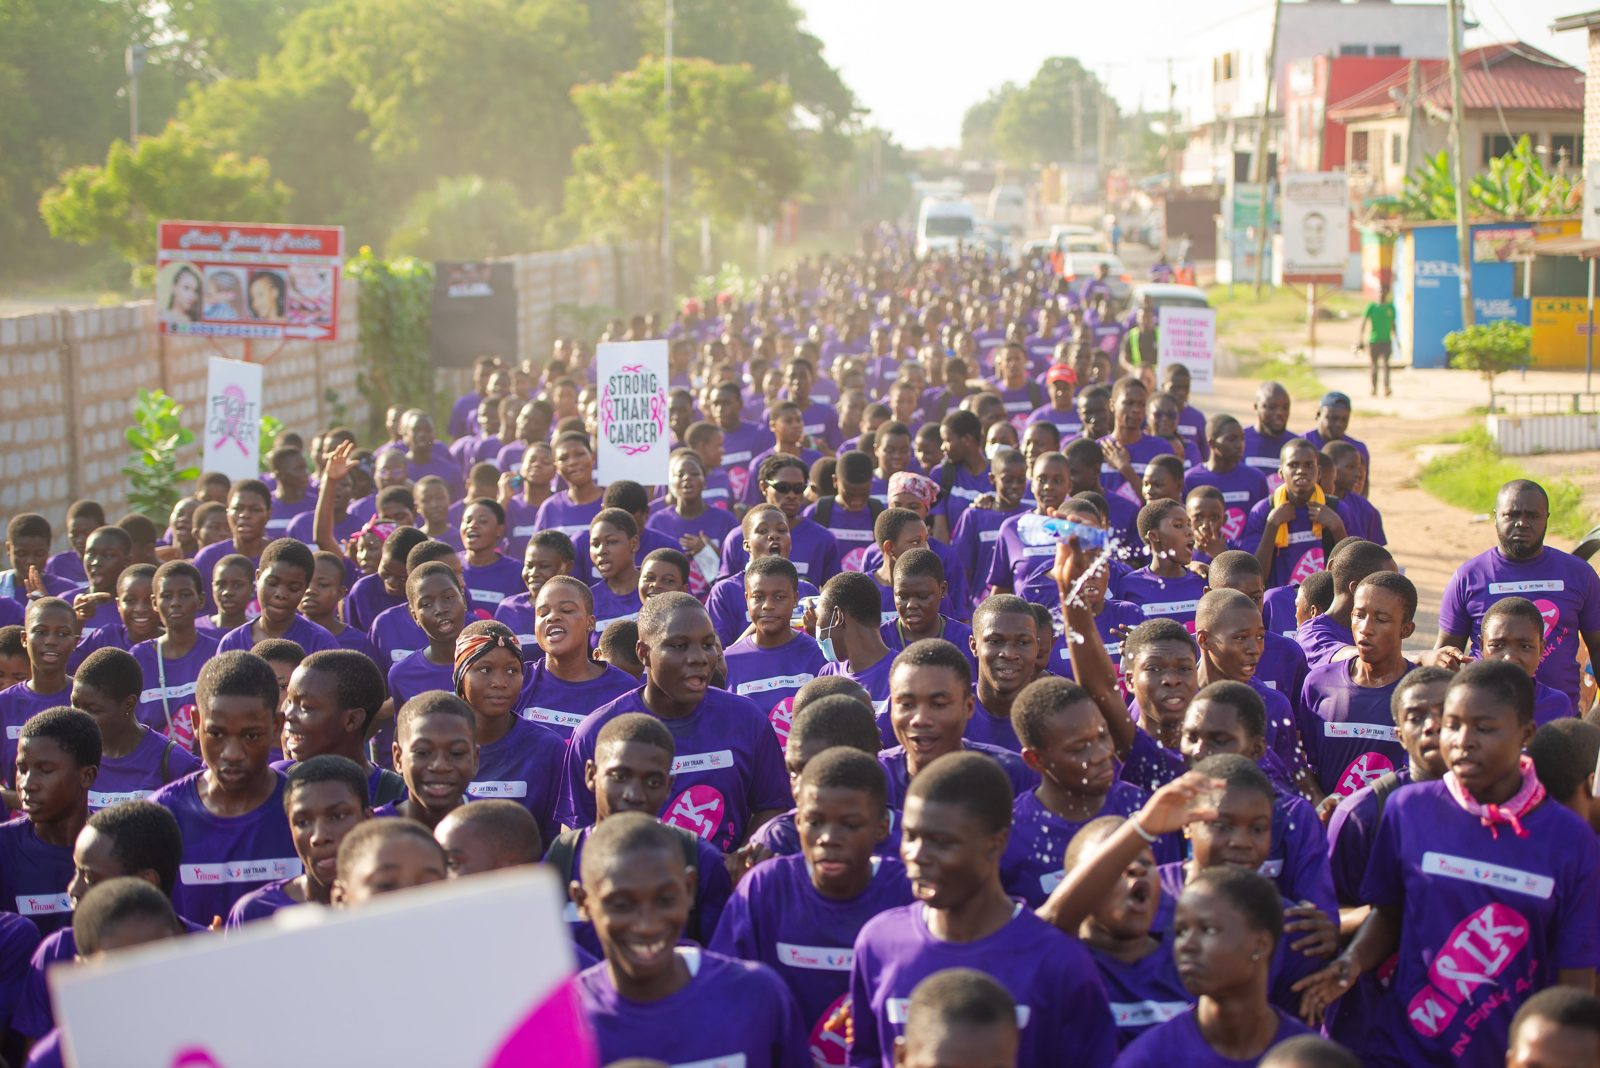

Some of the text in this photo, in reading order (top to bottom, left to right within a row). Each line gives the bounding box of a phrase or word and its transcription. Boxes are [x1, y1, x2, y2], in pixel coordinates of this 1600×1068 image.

[609, 373, 657, 396] STRONG
[614, 397, 650, 420] THAN
[609, 422, 657, 444] CANCER
[1451, 1033, 1471, 1057] IN
[1464, 989, 1510, 1031] PINK
